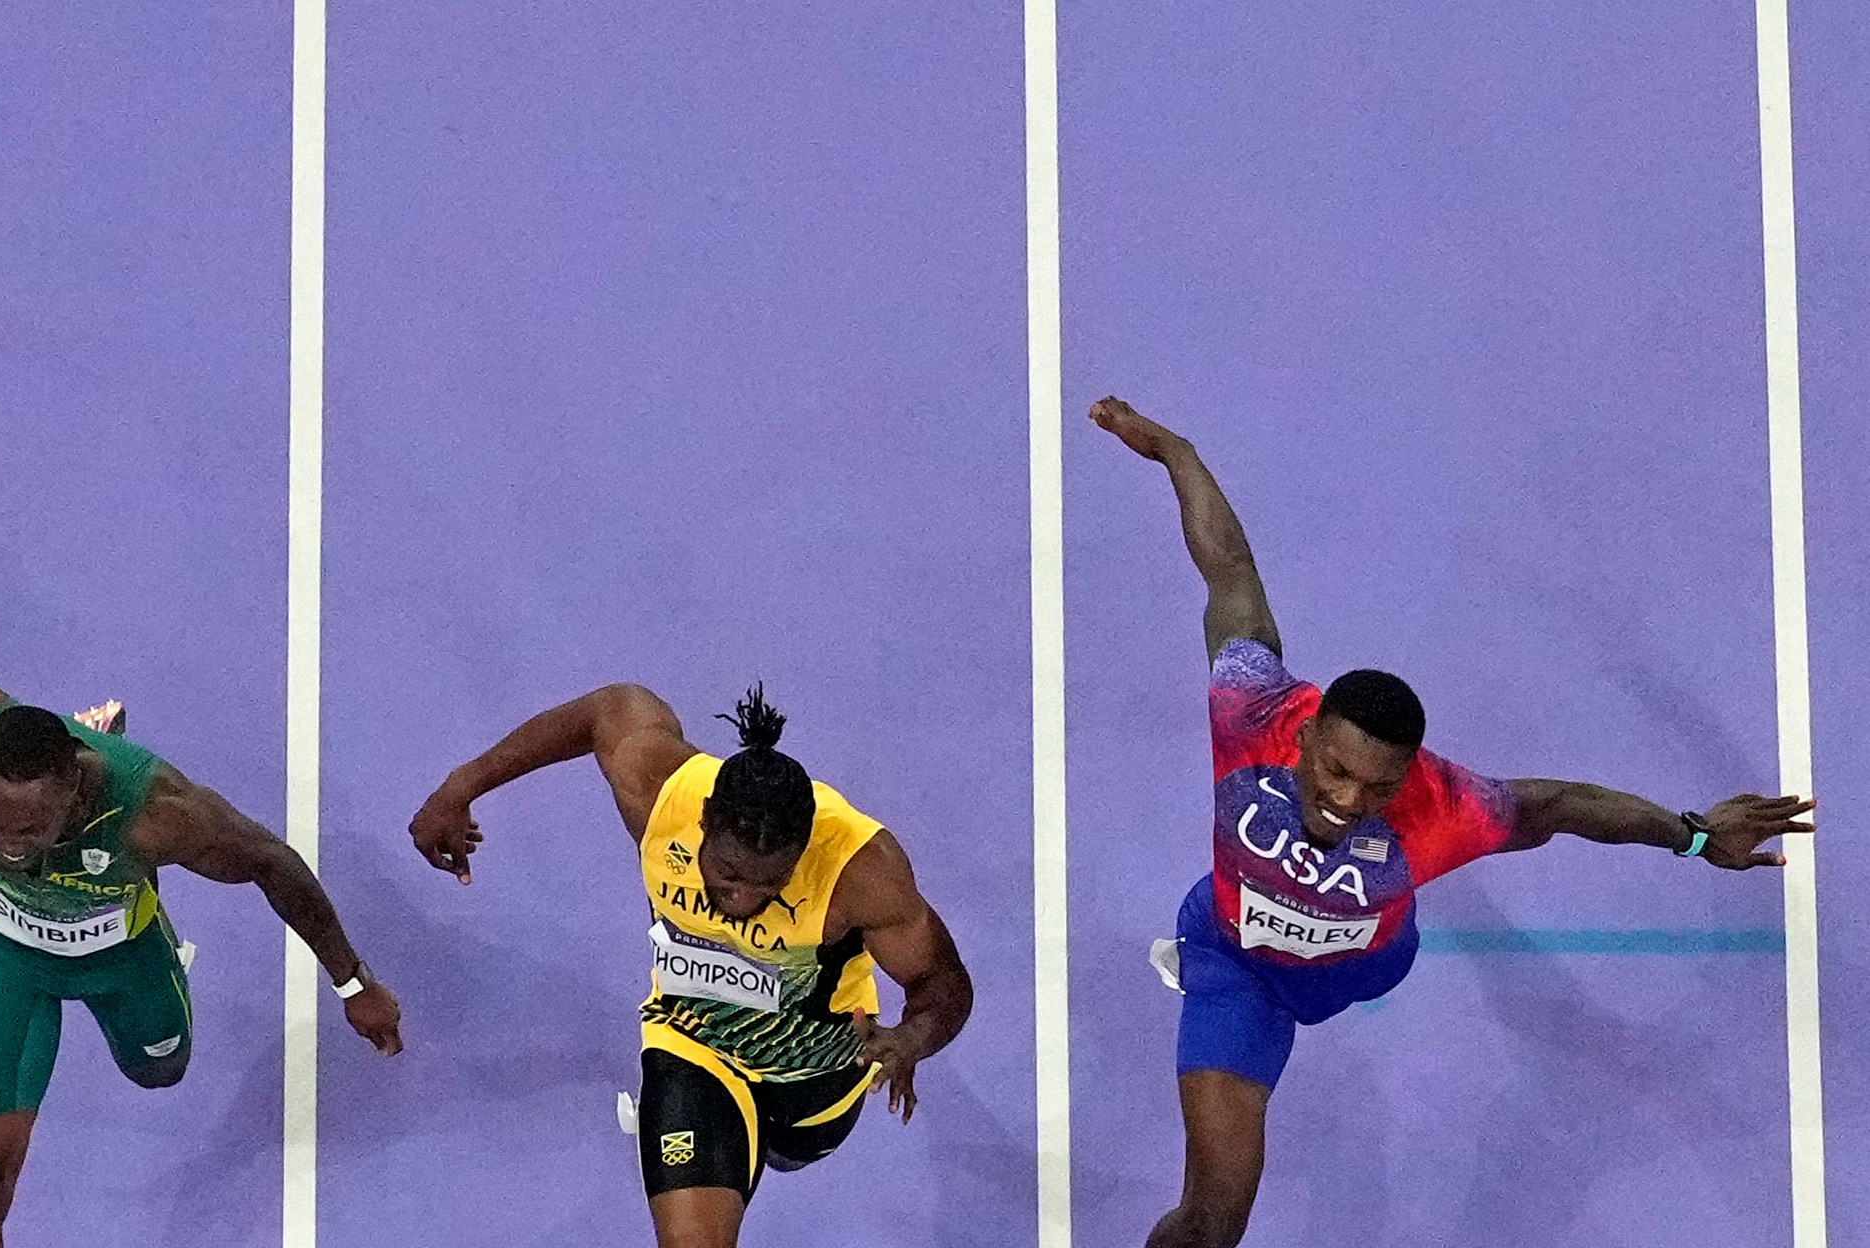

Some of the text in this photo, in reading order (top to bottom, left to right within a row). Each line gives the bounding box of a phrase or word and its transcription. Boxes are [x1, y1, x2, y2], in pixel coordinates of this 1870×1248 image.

[1237, 802, 1369, 907] USA
[656, 881, 788, 952] JAMAICA
[1245, 905, 1366, 945] KERLEY
[654, 942, 776, 998] HOMPSON
